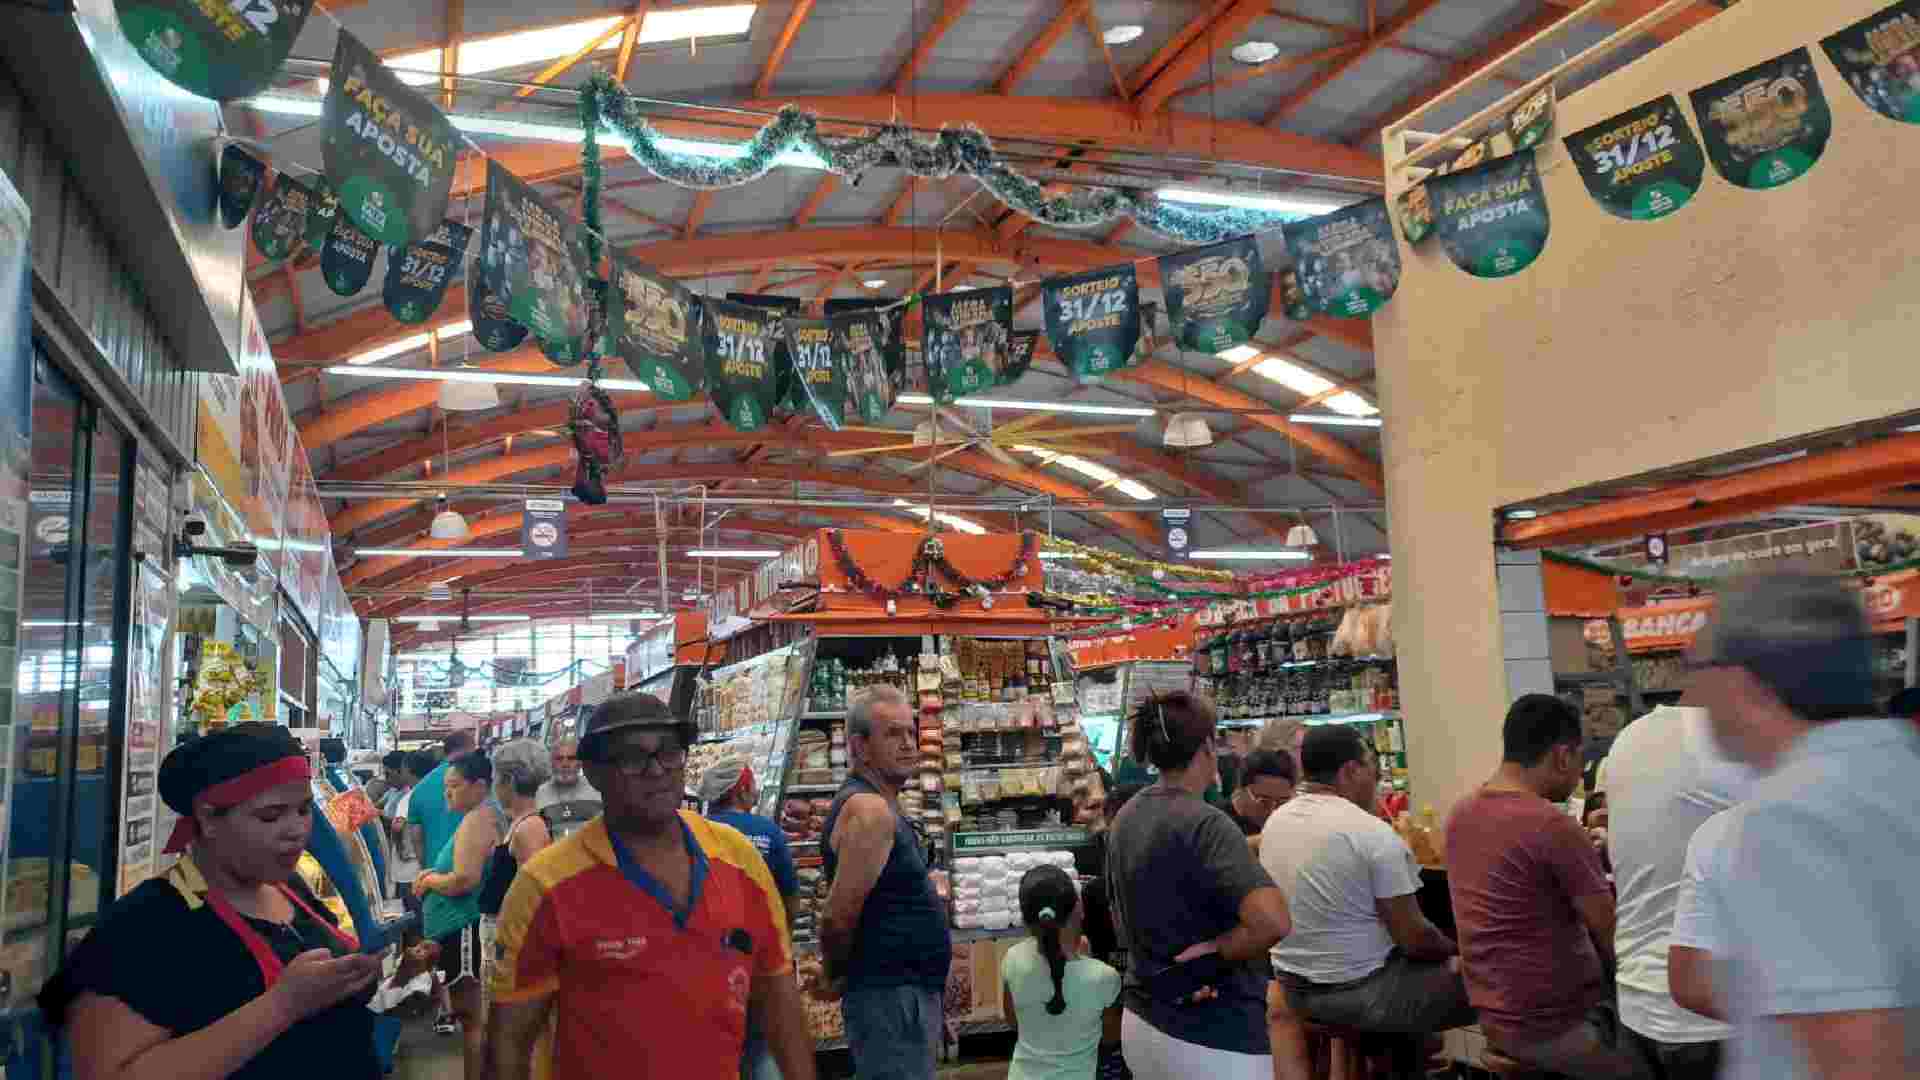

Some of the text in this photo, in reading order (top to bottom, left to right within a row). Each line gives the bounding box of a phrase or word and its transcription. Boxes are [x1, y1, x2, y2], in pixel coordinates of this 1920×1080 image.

[1583, 112, 1661, 151] SORTEIO
[344, 111, 431, 192] APOSTA
[1593, 126, 1676, 175] 31/12
[1615, 149, 1674, 183] APOSTE
[1496, 175, 1533, 198] SUA
[1456, 196, 1531, 231] APOSTA
[401, 255, 446, 282] 31/12
[1062, 277, 1121, 298] SORTEIO
[1058, 289, 1129, 322] 31/12
[1067, 314, 1121, 336] APOSTE
[716, 335, 766, 363] 31/12
[798, 342, 833, 369] 31/12
